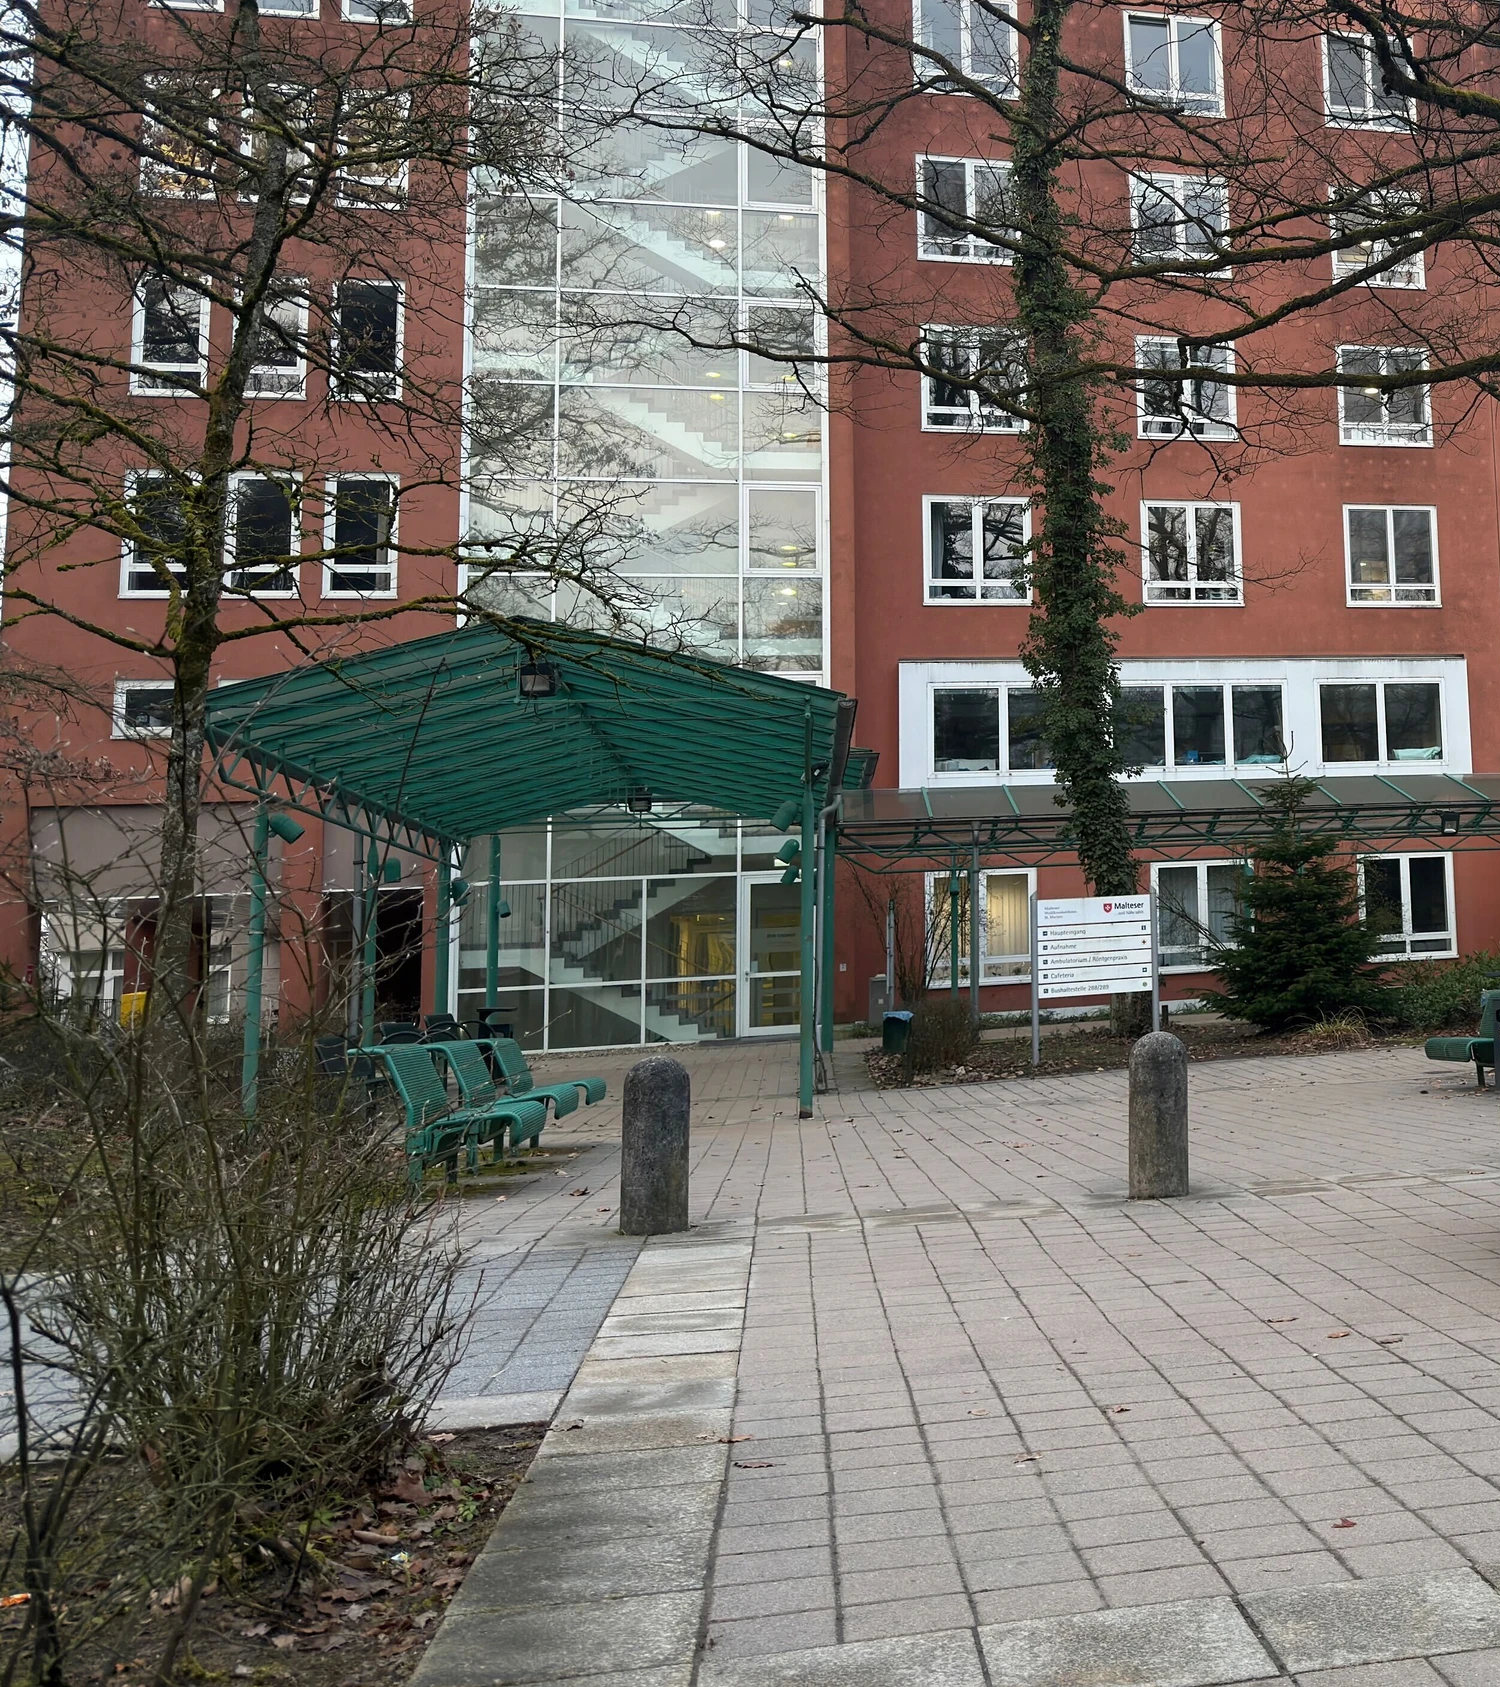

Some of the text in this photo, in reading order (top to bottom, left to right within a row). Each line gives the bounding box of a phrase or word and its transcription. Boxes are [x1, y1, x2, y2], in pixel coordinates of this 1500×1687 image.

[1114, 902, 1144, 910] Malteser
[1050, 956, 1088, 964] Ambulatorium
[1092, 955, 1128, 963] Röntgenpraxis
